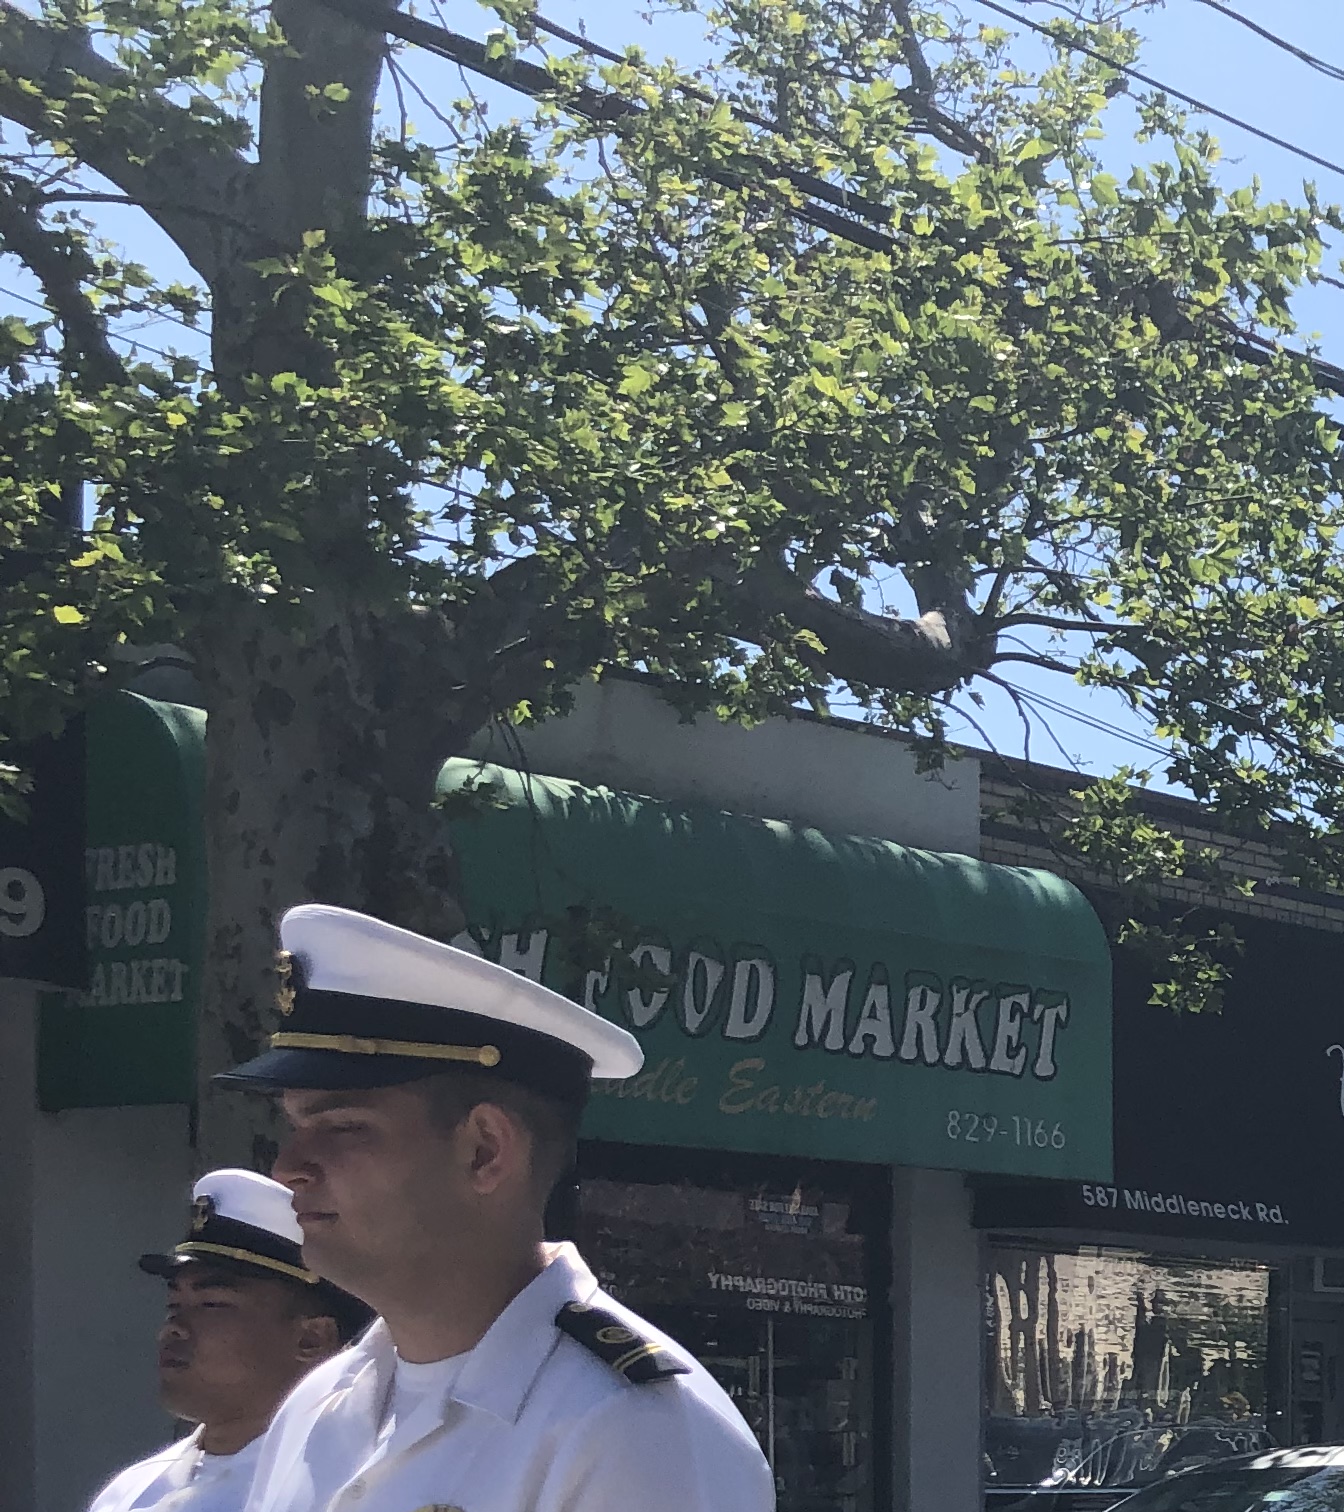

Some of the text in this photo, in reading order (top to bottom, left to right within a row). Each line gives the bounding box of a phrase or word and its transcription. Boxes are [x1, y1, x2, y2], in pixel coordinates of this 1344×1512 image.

[78, 958, 189, 1006] ARKET
[794, 969, 1068, 1078] MARKET
[719, 1057, 878, 1122] Eastern
[946, 1110, 1066, 1150] 829-1166
[1082, 1184, 1289, 1225] 587 Middleneck Rd.
